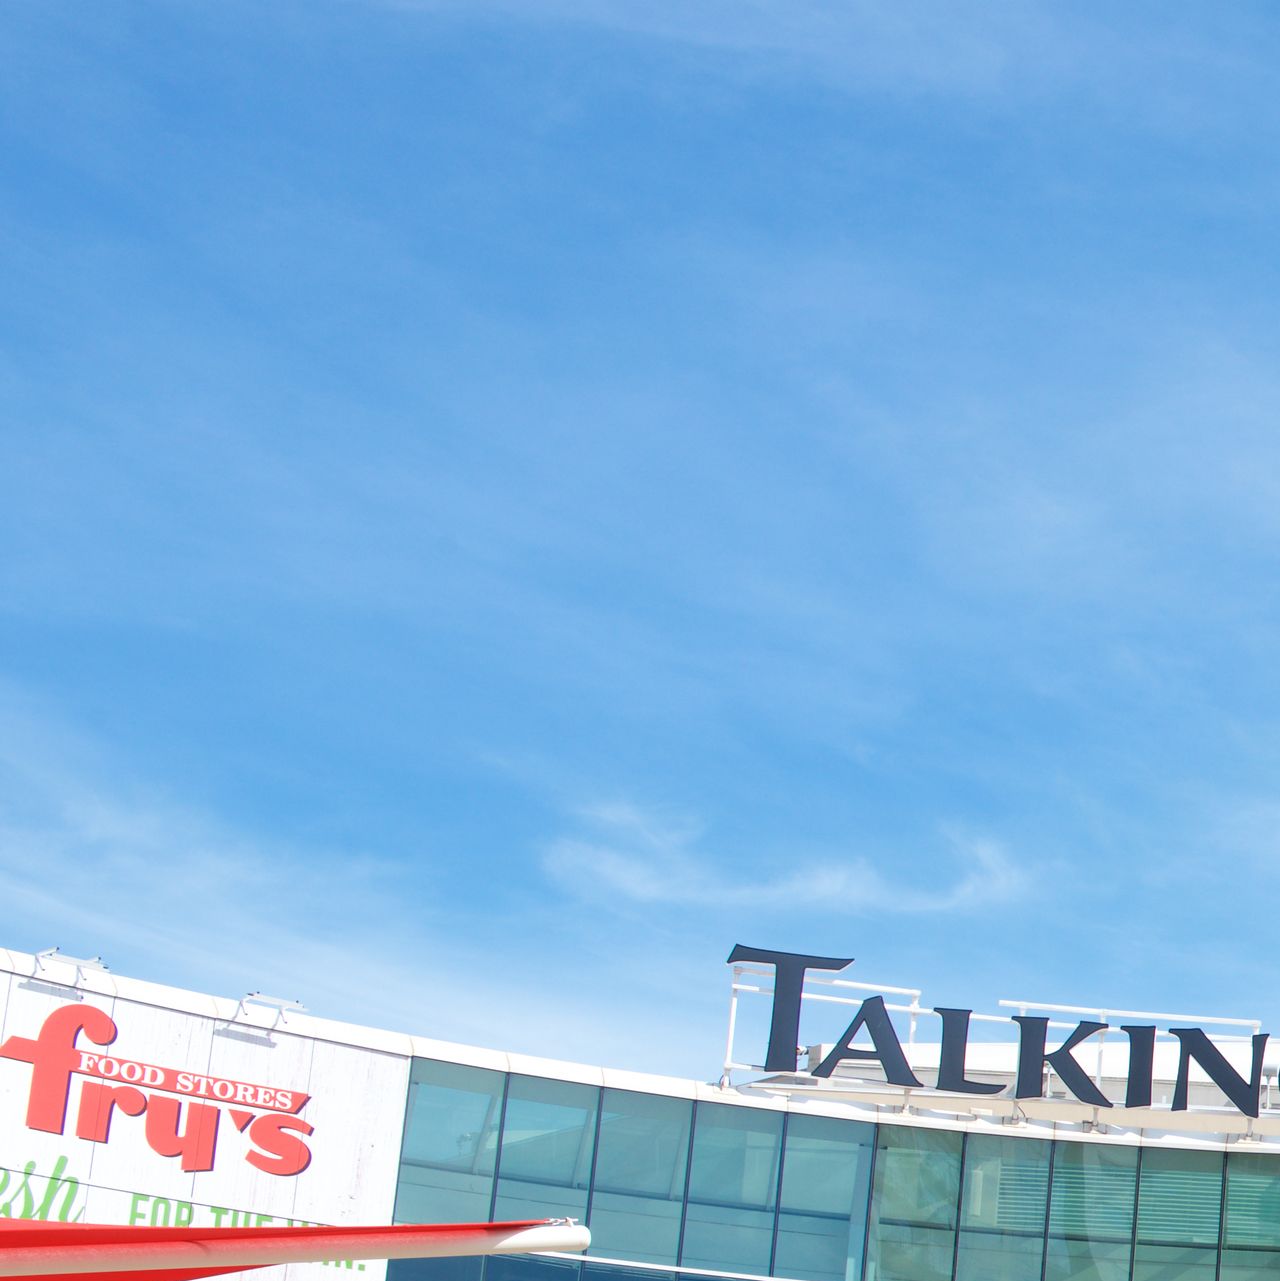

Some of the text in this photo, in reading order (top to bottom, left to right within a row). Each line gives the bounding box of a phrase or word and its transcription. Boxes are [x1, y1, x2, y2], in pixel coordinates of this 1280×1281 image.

[0, 1004, 314, 1177] fry's
[78, 1052, 293, 1110] FOOD STORES
